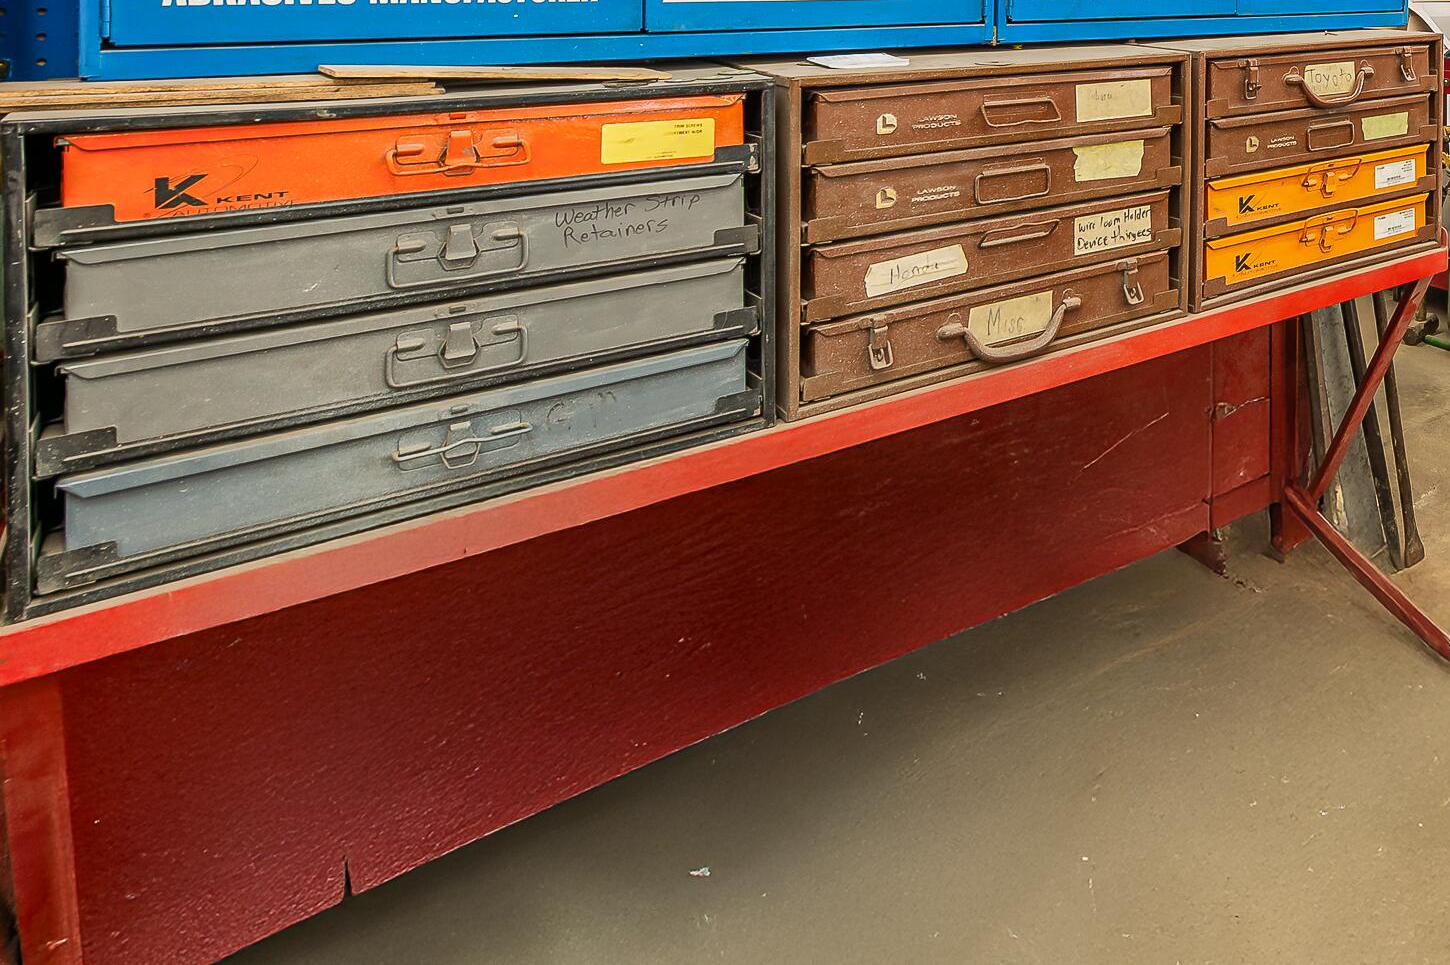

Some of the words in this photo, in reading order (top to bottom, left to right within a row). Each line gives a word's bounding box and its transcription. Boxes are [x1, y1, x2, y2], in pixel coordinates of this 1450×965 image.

[917, 113, 958, 123] LAWSON
[912, 119, 961, 130] PRODUCTS
[917, 186, 958, 195] LAWSON
[217, 191, 289, 203] KENT
[912, 191, 960, 203] PRODUCTS
[555, 202, 636, 227] Weather
[644, 194, 700, 212] Strip
[1257, 203, 1279, 211] KENT
[563, 219, 668, 247] Retainers
[1254, 260, 1276, 269] KENT
